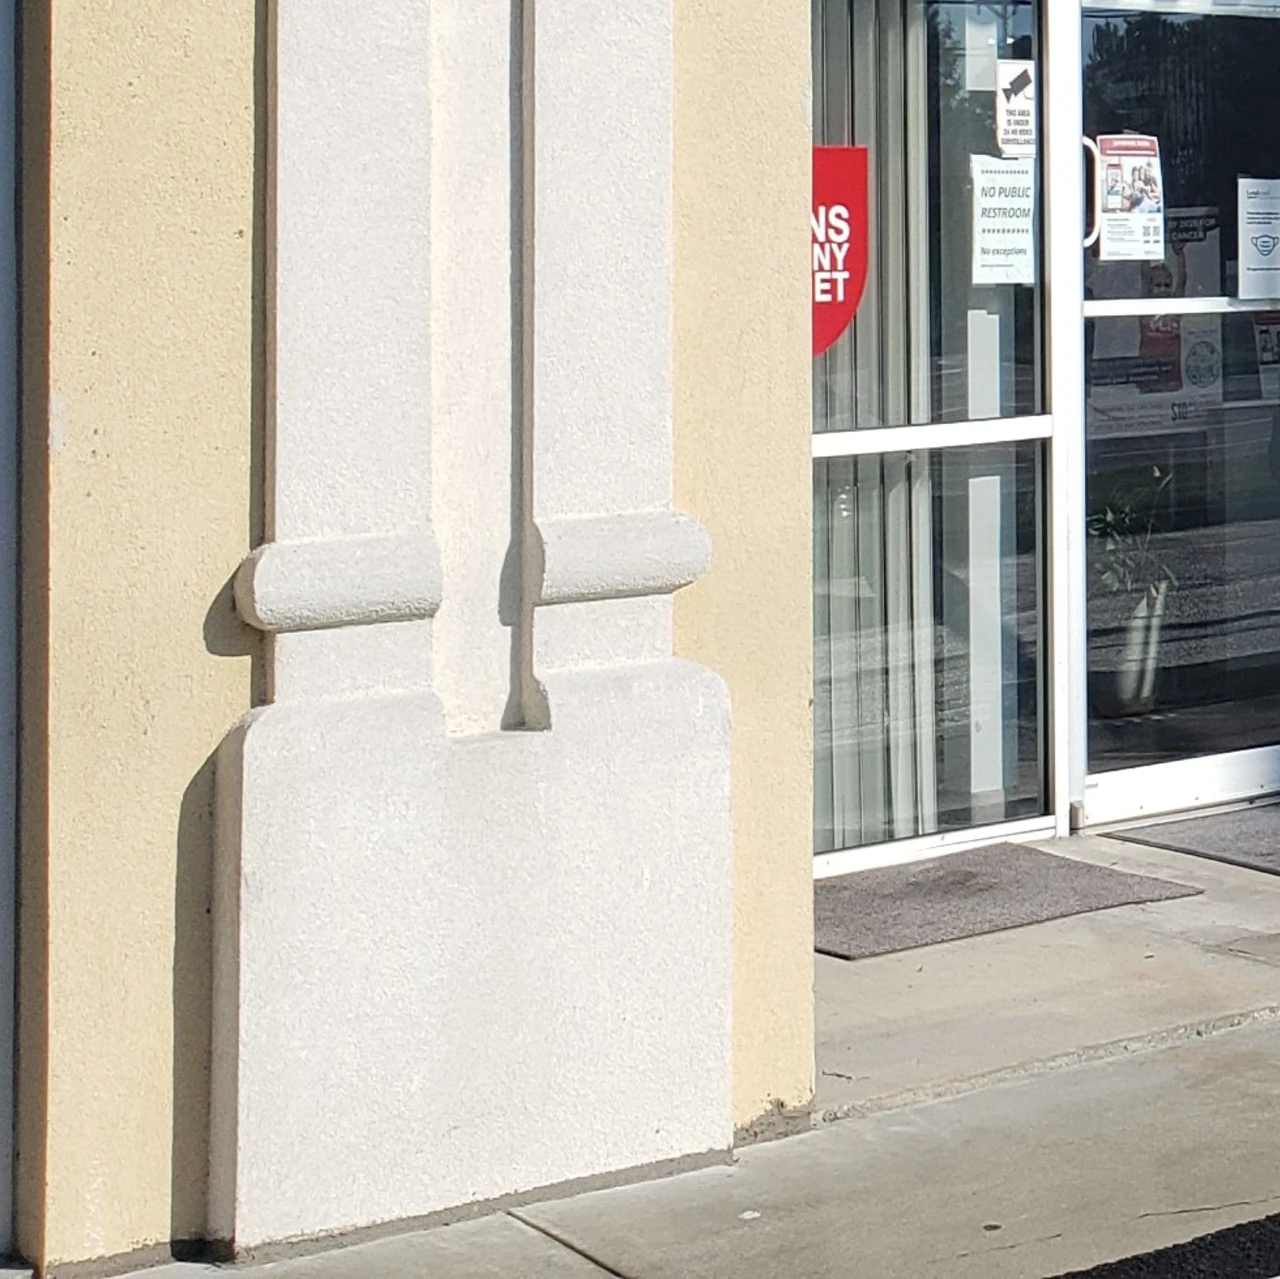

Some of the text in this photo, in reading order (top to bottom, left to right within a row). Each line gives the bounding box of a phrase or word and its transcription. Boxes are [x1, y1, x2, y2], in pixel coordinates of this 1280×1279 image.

[981, 186, 1031, 199] NO PUBLIC
[981, 207, 1031, 219] RESTROOM
[813, 243, 850, 271] NY
[980, 247, 1028, 258] No exceptions
[814, 271, 850, 302] ET
